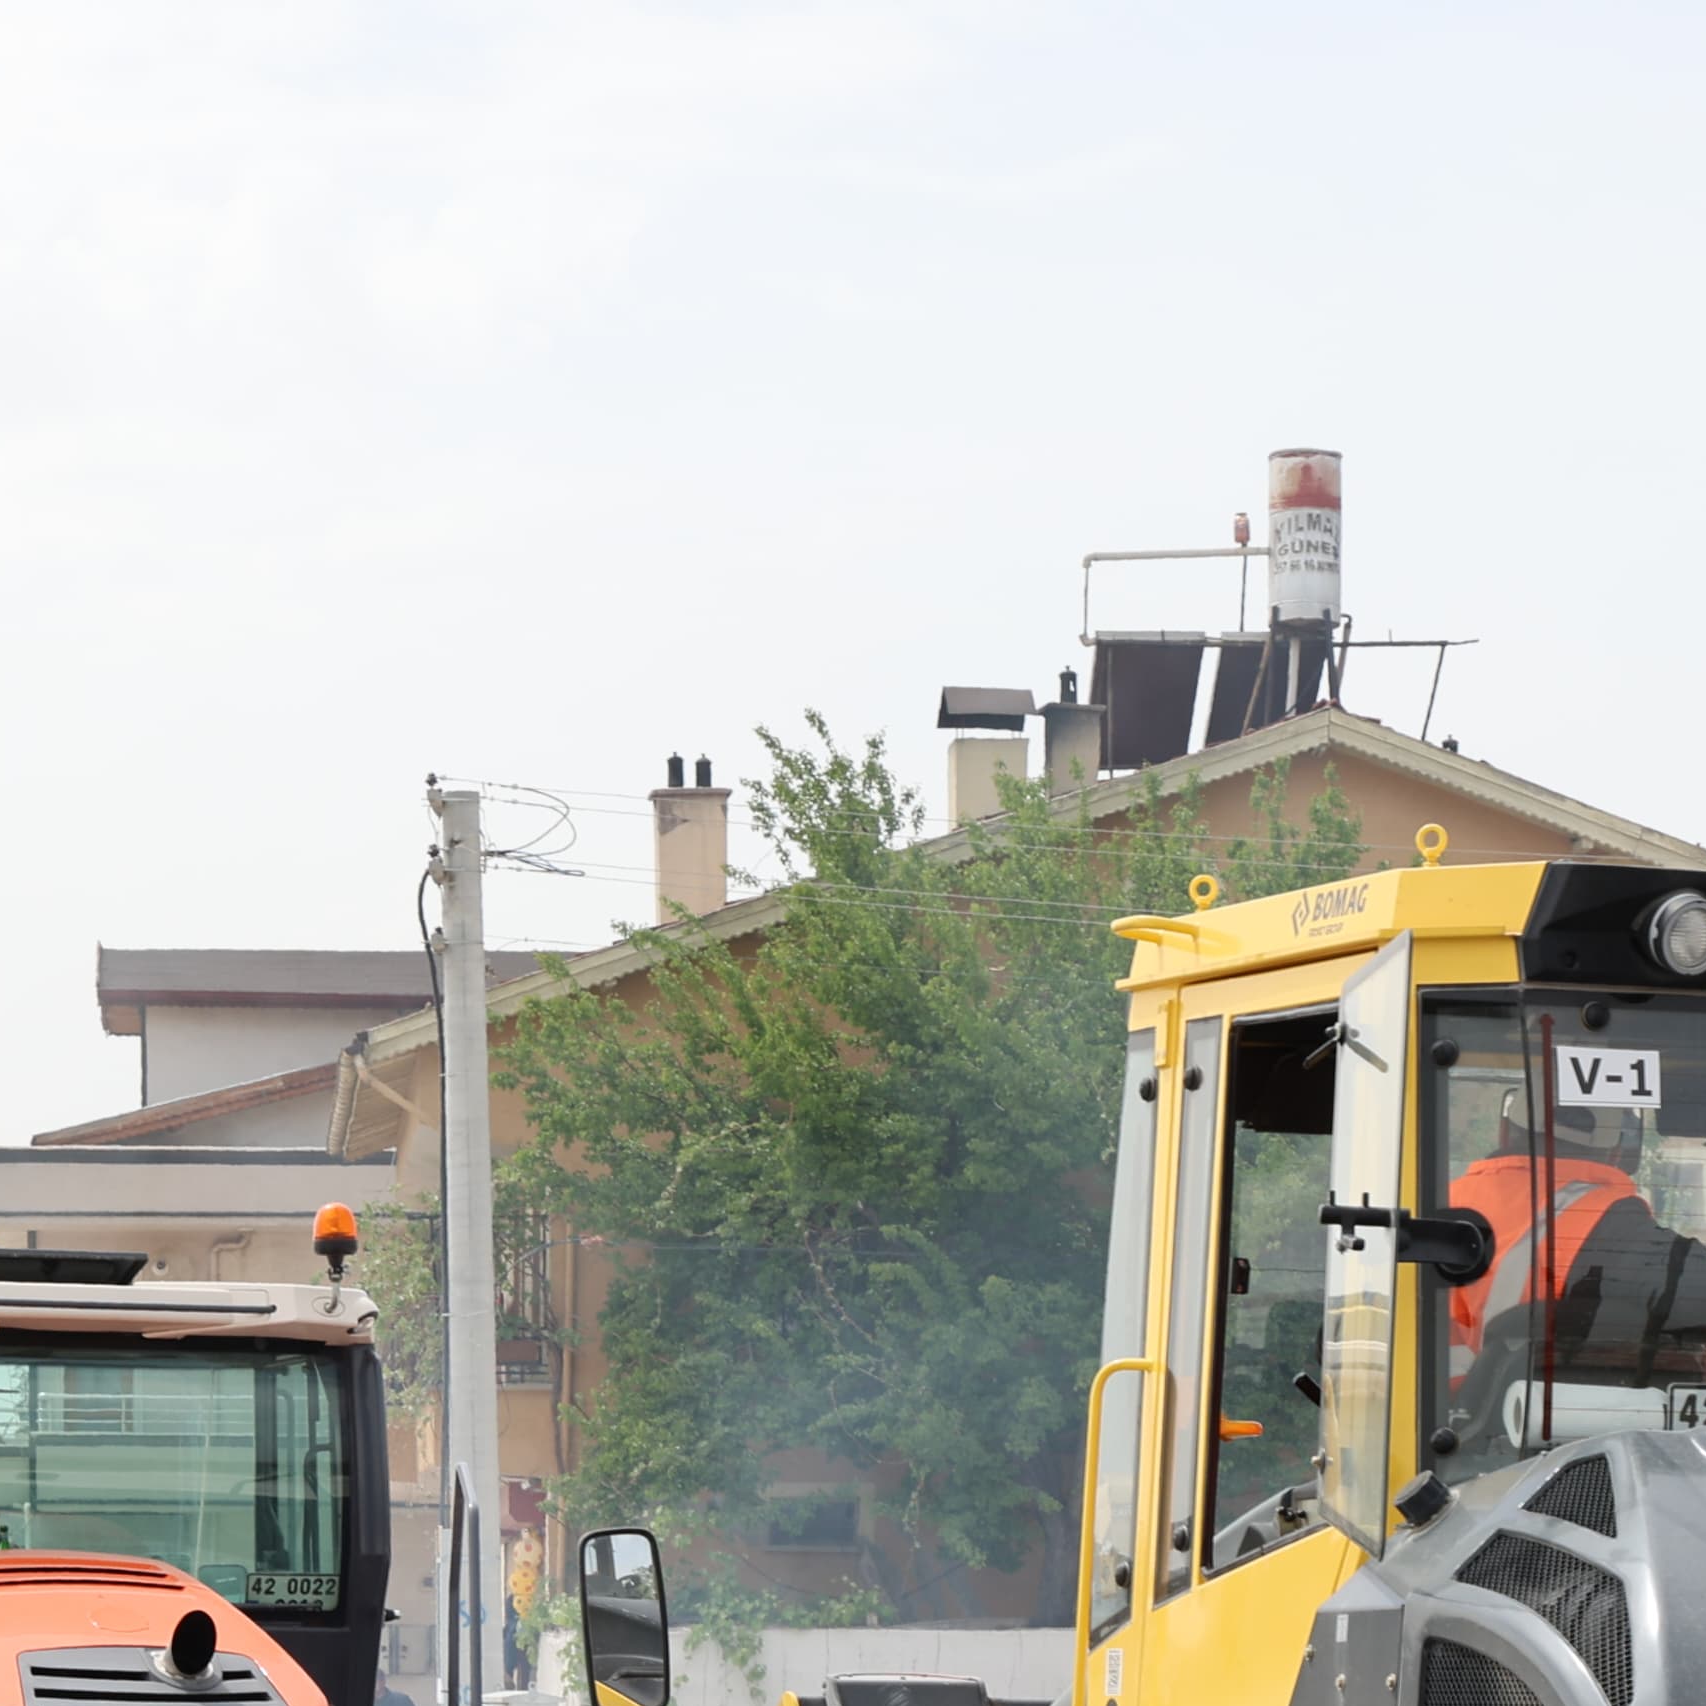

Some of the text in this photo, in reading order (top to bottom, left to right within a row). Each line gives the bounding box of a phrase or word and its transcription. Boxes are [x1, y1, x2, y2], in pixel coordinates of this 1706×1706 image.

[1312, 883, 1370, 922] BOMAG
[1569, 1056, 1654, 1097] V-1
[251, 1577, 337, 1596] 42 0022
